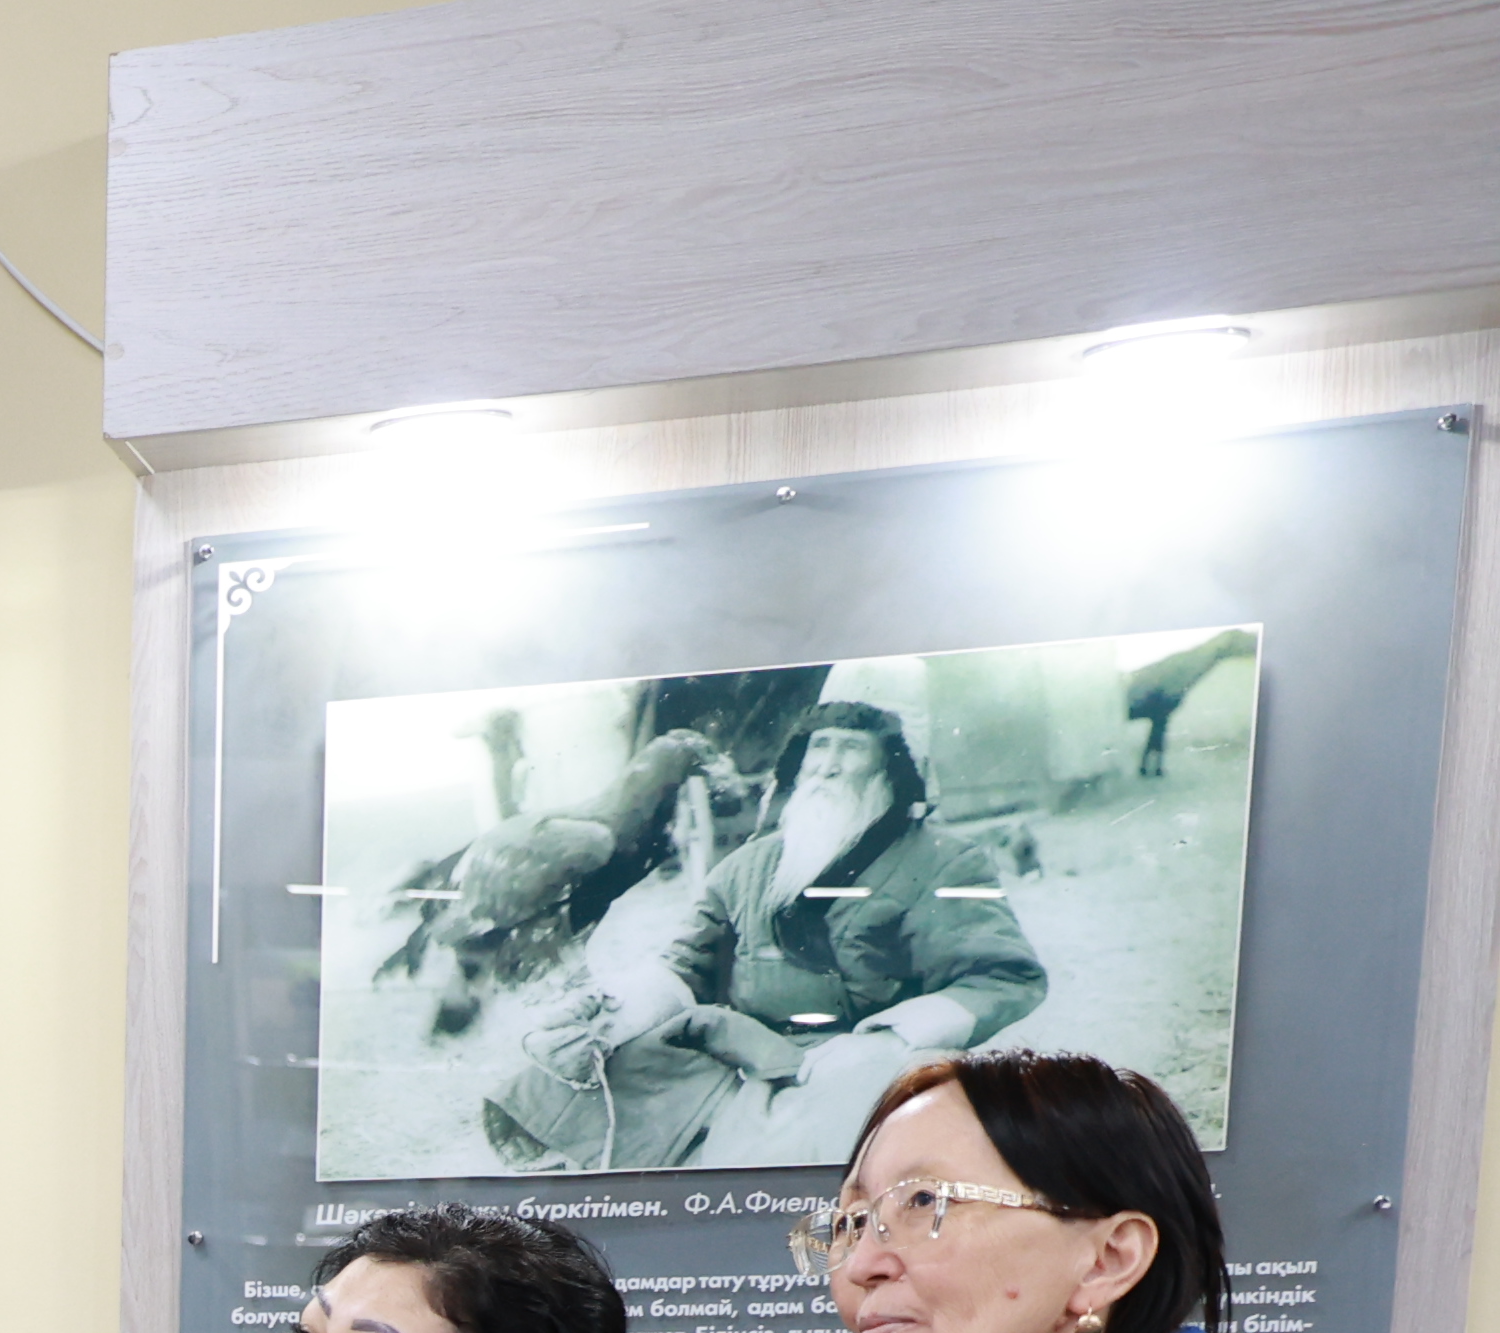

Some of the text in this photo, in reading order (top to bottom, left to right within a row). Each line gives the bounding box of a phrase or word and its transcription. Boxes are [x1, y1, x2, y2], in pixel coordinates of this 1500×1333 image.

[684, 1190, 840, 1215] Ф.А.Фиельс
[245, 1261, 1317, 1299] Бізше, дамдар тату тұруға ақыл
[651, 1298, 737, 1317] болмай,
[748, 1302, 803, 1317] адам
[1244, 1314, 1312, 1333] білім-
